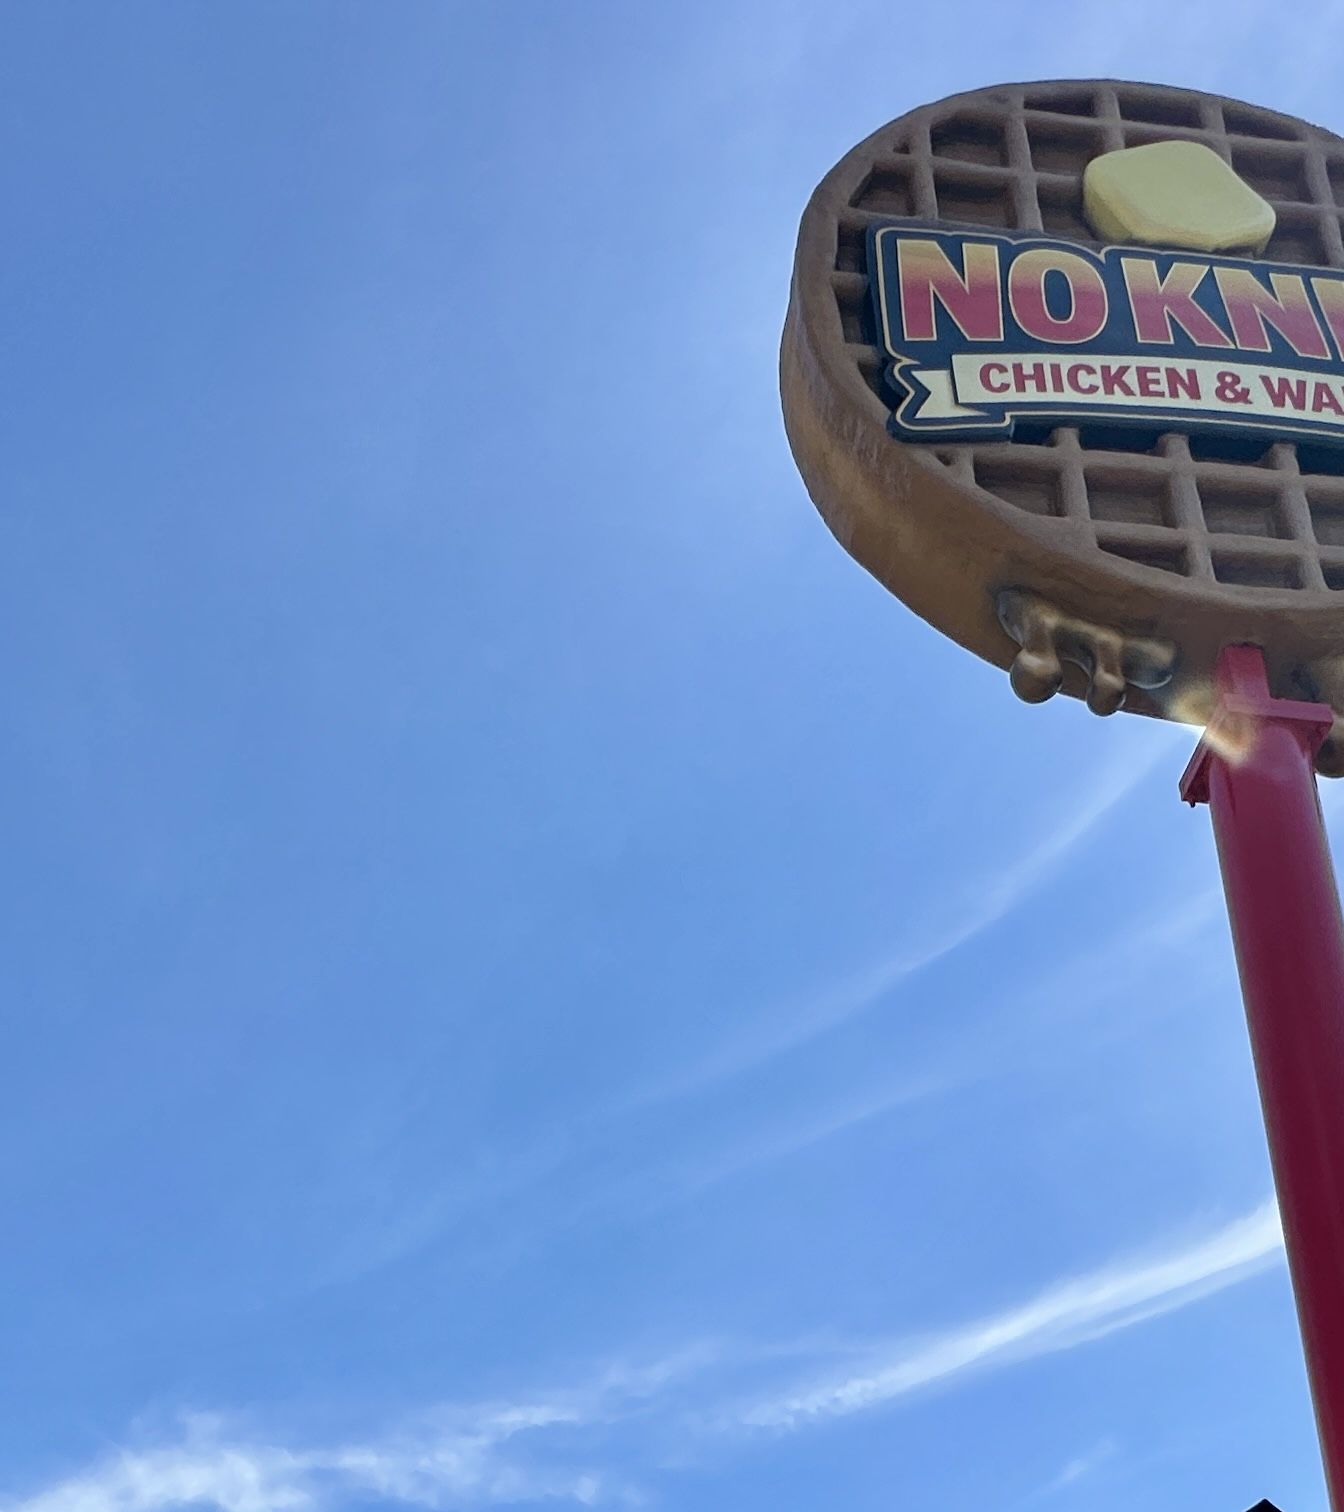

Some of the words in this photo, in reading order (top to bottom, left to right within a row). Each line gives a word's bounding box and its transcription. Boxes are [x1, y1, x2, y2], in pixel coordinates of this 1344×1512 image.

[896, 238, 1109, 345] NO
[978, 362, 1202, 402] CHICKEN
[1214, 370, 1254, 406] &
